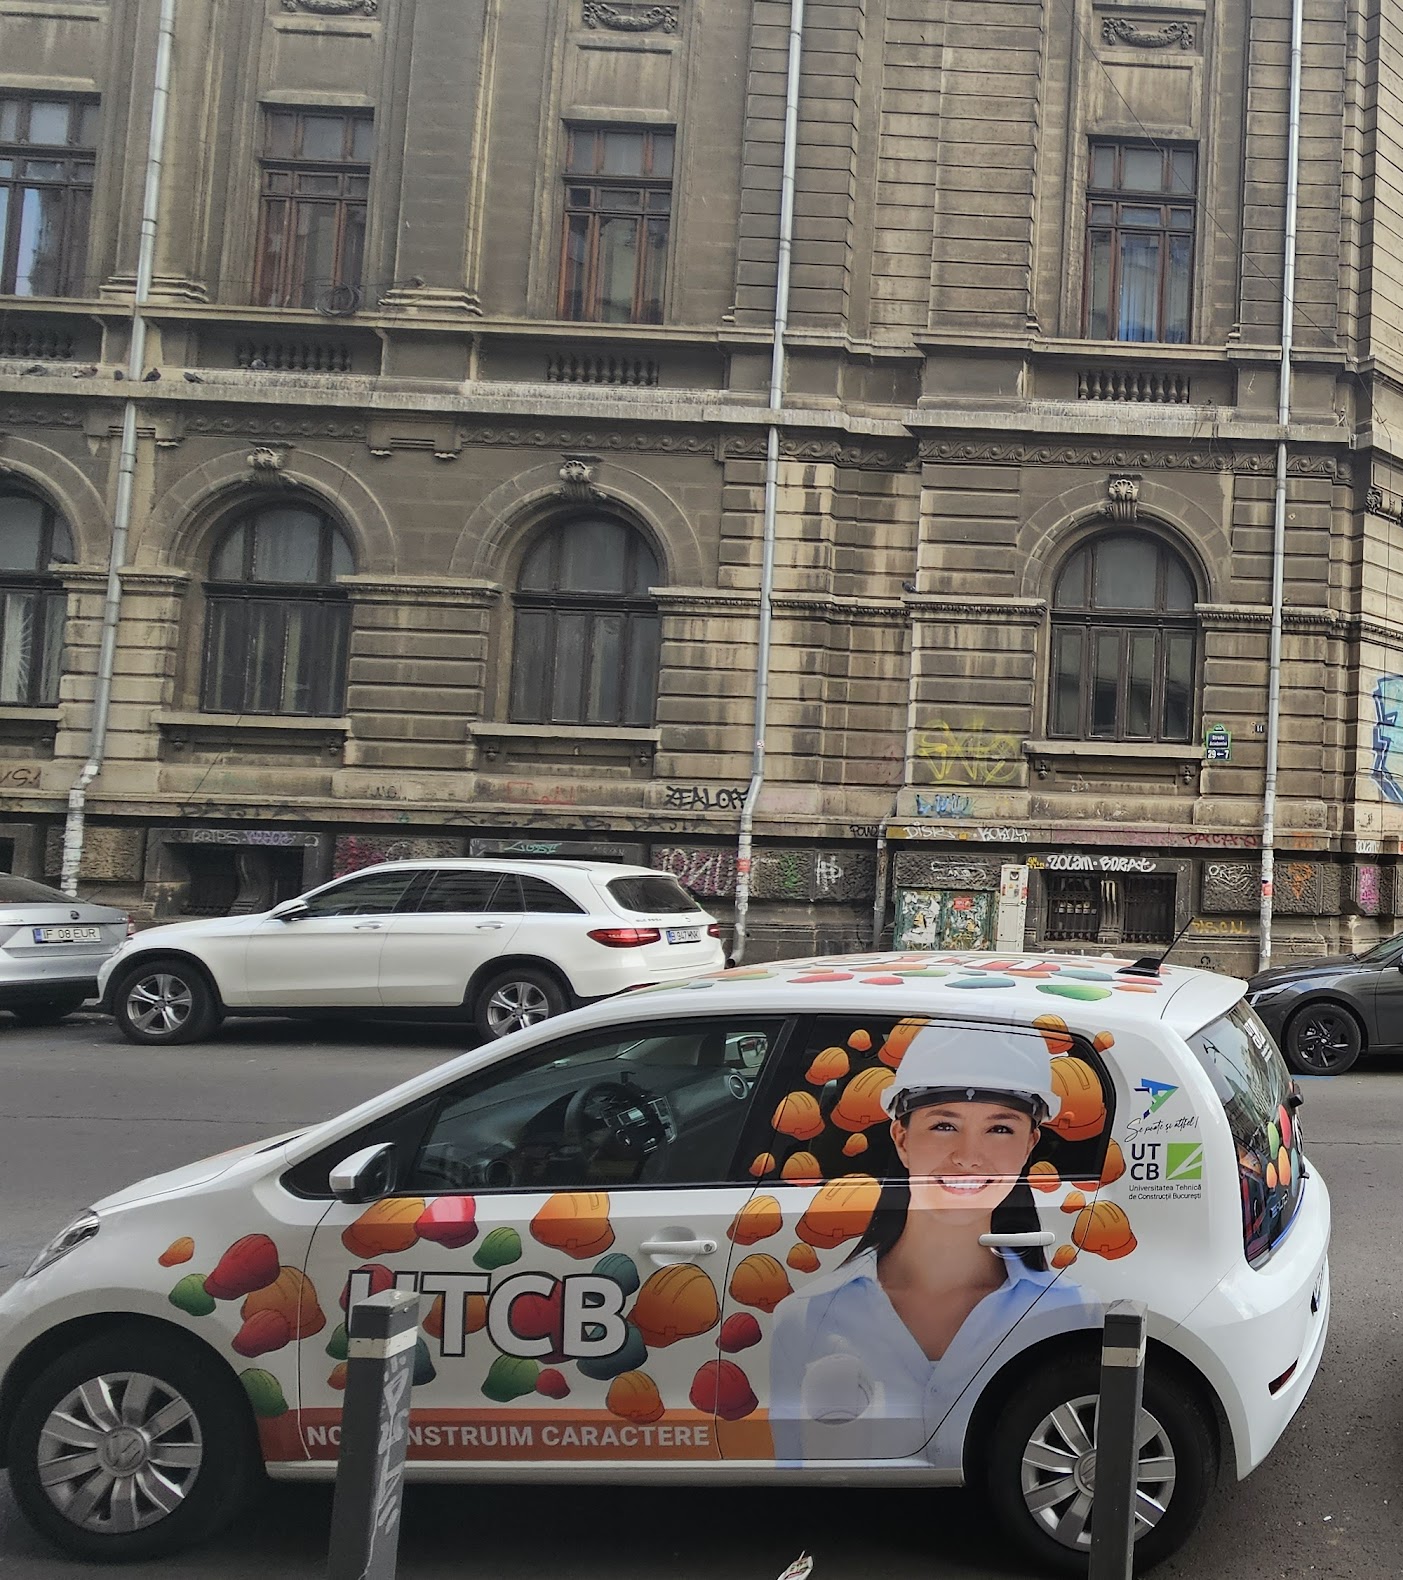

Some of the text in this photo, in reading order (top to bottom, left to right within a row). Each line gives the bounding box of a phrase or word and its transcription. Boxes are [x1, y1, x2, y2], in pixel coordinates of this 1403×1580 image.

[1207, 749, 1230, 759] 29 7
[43, 928, 96, 939] IF 08 EUR
[1131, 1143, 1161, 1161] UT
[1130, 1163, 1160, 1181] CB
[1129, 1184, 1174, 1192] Universitatea
[408, 1426, 534, 1447] NSTRUIM
[542, 1426, 710, 1448] CARACTERE
